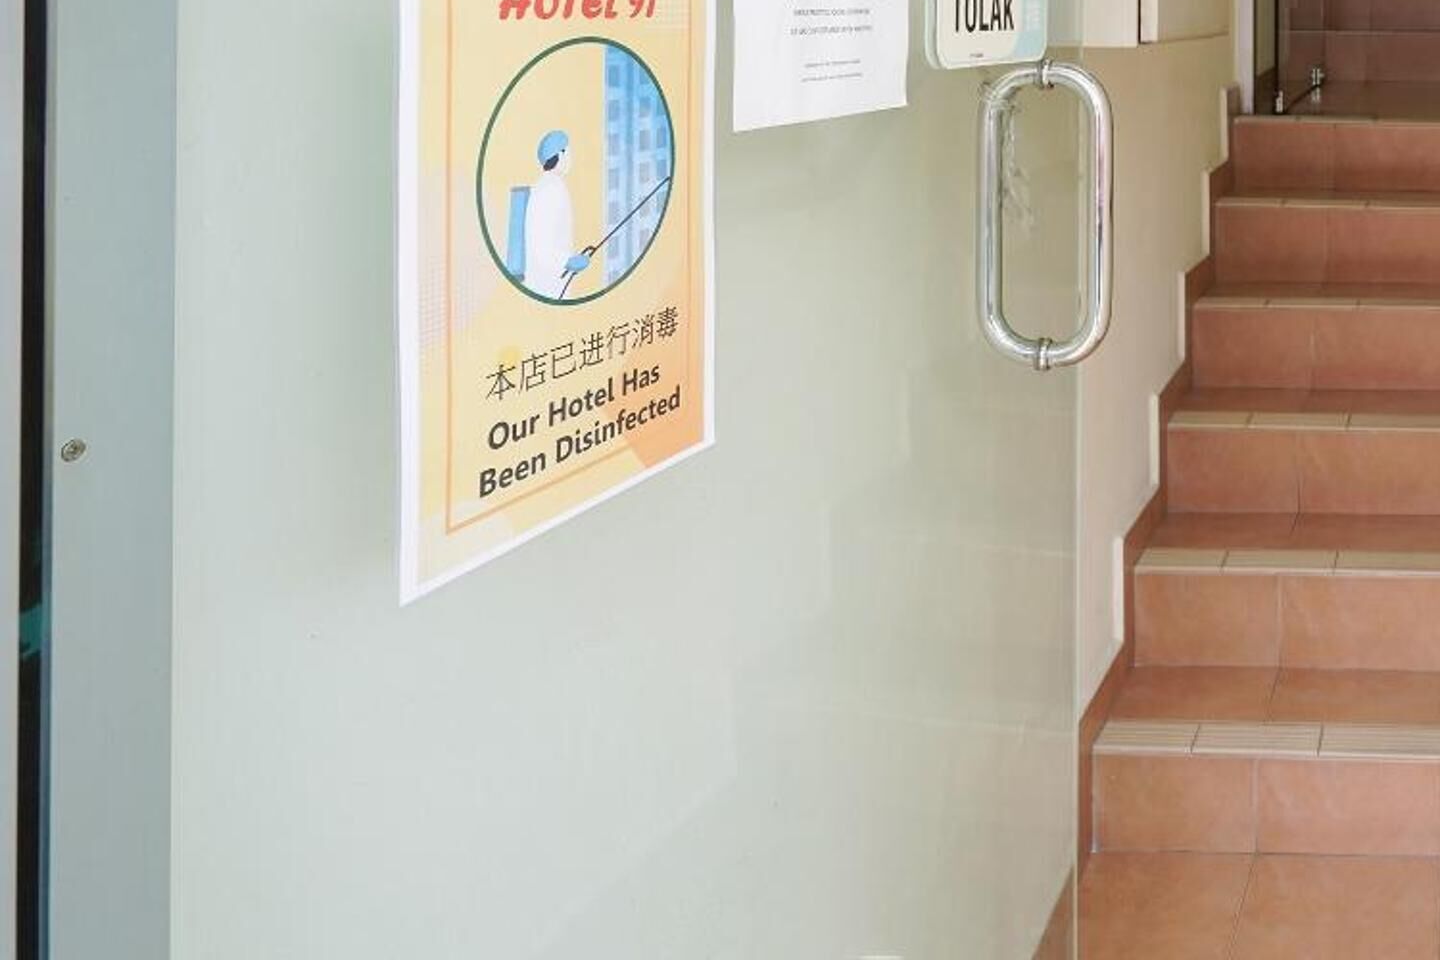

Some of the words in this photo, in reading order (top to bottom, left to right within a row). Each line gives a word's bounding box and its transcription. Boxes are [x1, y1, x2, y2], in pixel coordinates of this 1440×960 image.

[485, 306, 679, 400] 本店已进行消毒
[478, 451, 547, 499] Been
[555, 384, 681, 464] Disinfected
[487, 413, 541, 451] Our
[548, 377, 615, 428] Hotel
[622, 364, 661, 396] Has
